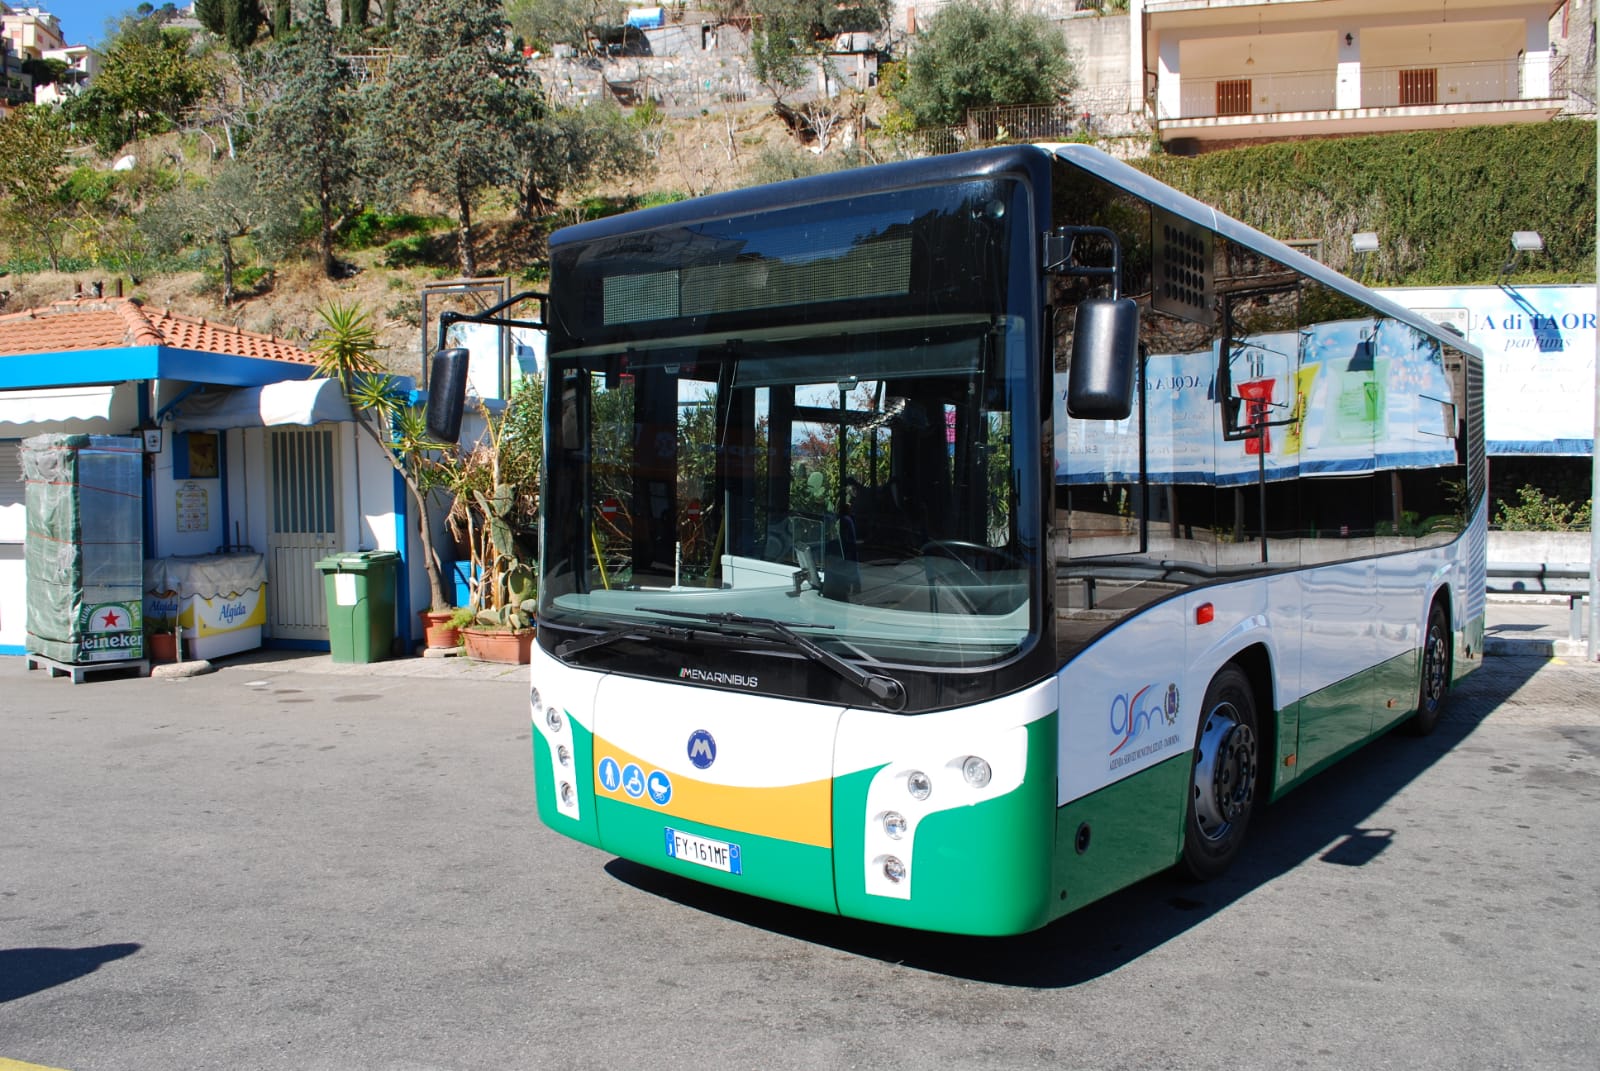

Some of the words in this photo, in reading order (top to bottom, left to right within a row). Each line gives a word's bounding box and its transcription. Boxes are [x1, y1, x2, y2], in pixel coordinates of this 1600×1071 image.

[1503, 314, 1522, 330] di
[1504, 335, 1572, 351] parfums
[219, 602, 247, 624] Algida
[682, 668, 758, 687] MENARINIBUS
[690, 738, 713, 760] M
